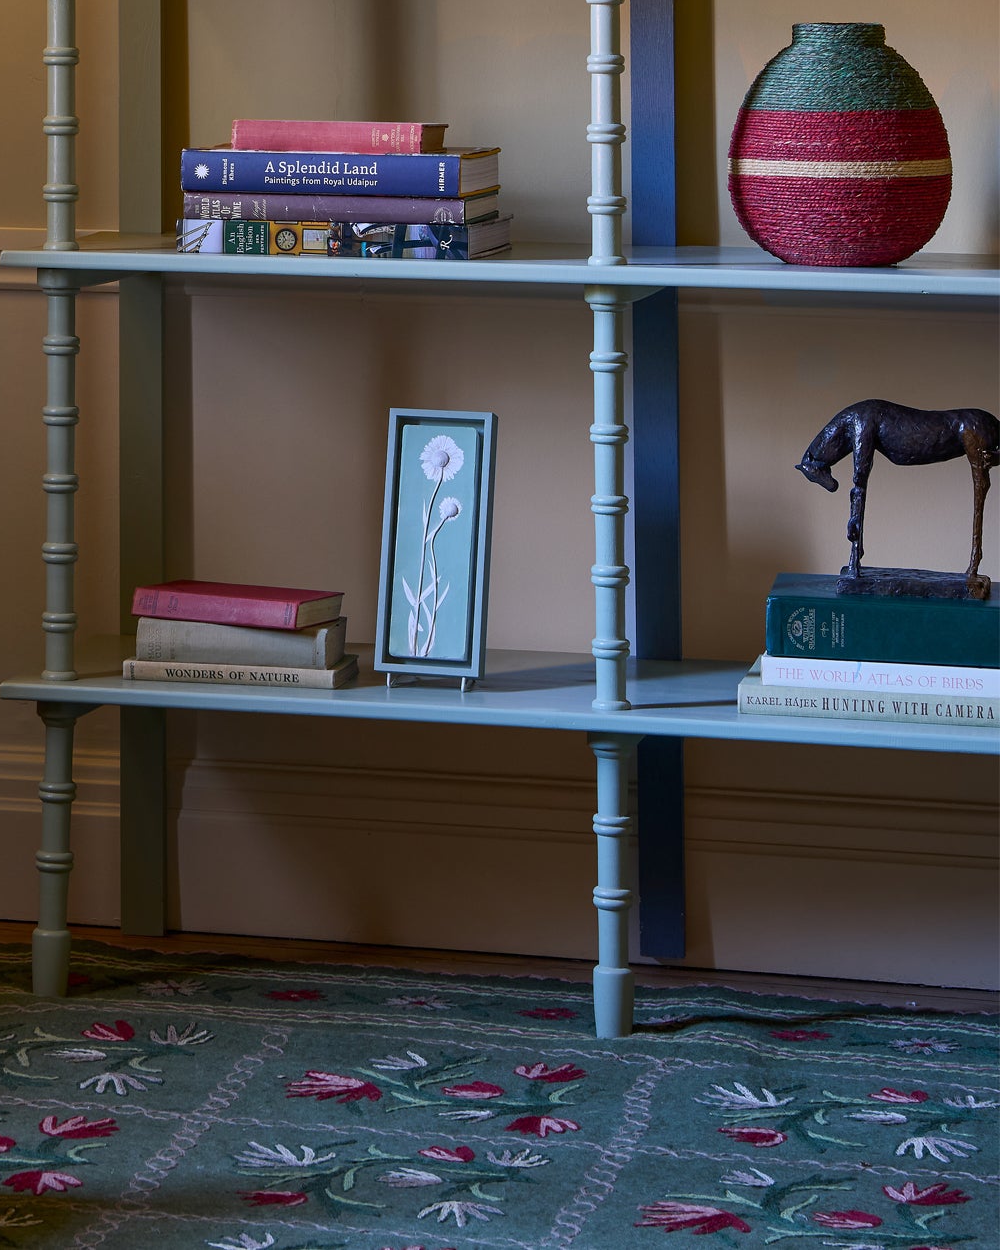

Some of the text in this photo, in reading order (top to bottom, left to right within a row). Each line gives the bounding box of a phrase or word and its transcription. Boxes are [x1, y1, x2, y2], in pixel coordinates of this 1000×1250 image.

[264, 160, 378, 177] A Splendid Land
[264, 176, 378, 188] Paintings from Royal Udaipur
[200, 197, 210, 219] WORLD
[211, 199, 221, 219] ATLAS
[221, 205, 230, 215] OF
[231, 201, 241, 219] WINE
[228, 232, 236, 244] An
[236, 223, 246, 254] English
[165, 669, 300, 683] WONDERS OF NATURE
[776, 668, 984, 690] THE WORLD ATLAS OF BIRDS
[747, 696, 994, 720] KAREL HÁJEK HUNTING WITH CAMERA
